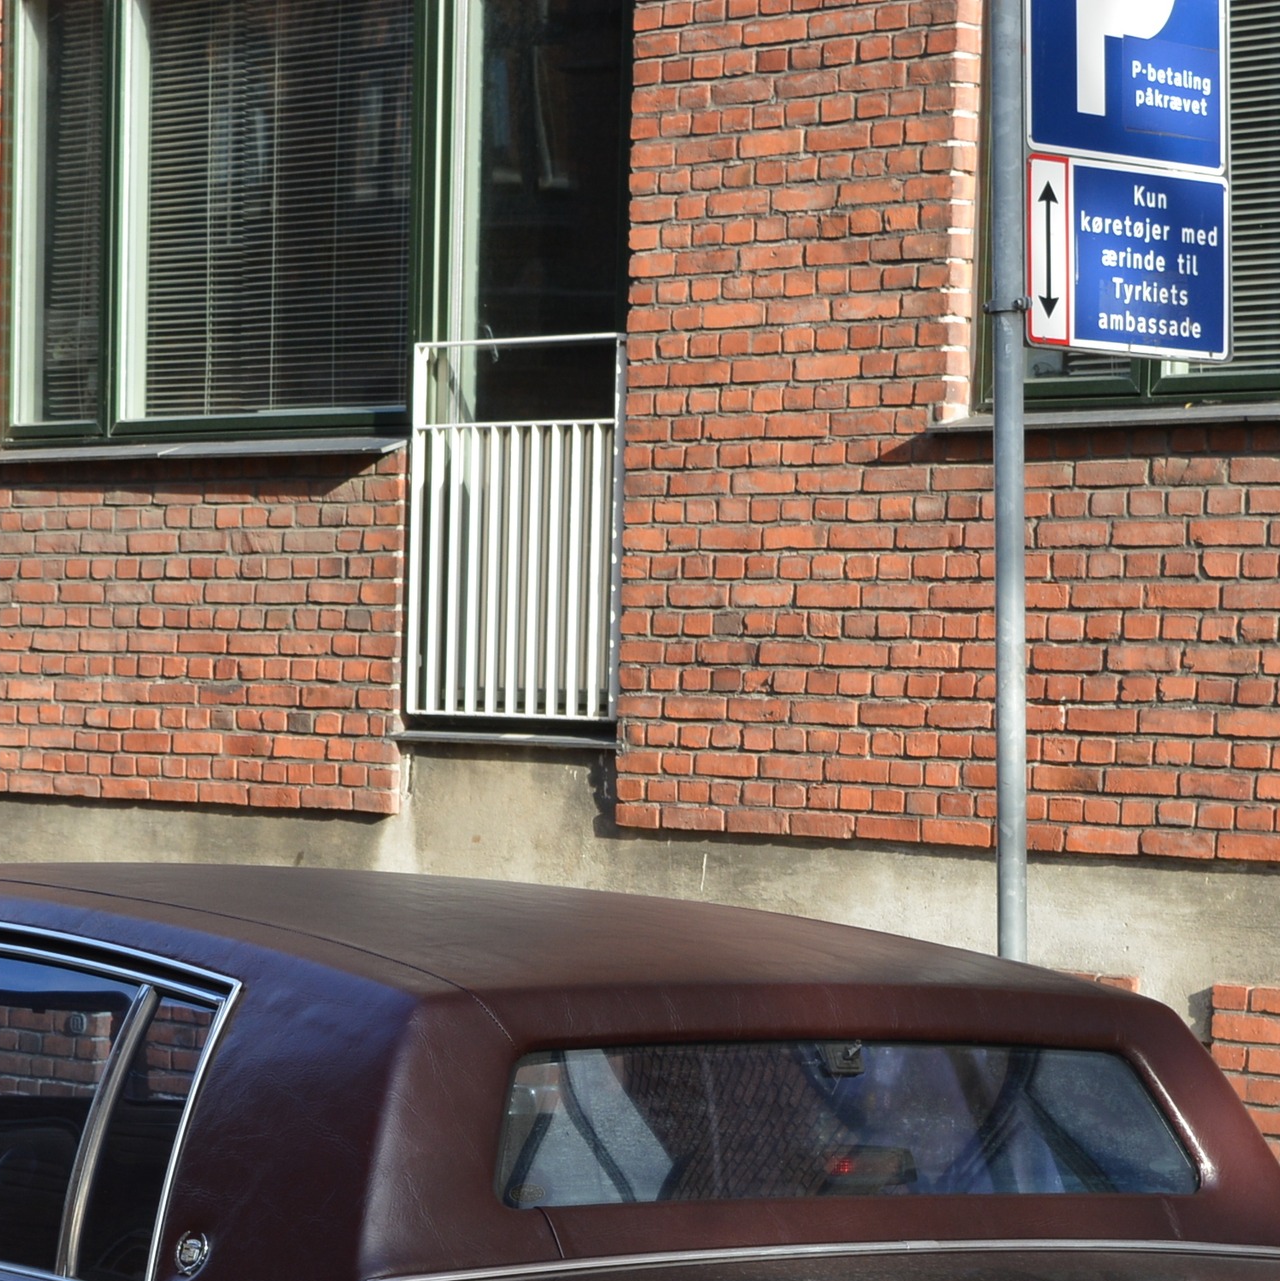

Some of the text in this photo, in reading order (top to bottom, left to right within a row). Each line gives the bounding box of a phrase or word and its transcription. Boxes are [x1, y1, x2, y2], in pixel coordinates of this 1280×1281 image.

[1131, 60, 1212, 96] P-betaling
[1135, 87, 1208, 116] påkrævet
[1133, 184, 1167, 209] Kun
[1080, 210, 1218, 247] køretøjer med
[1101, 247, 1199, 276] ærinde til
[1112, 276, 1189, 306] Tyrkiets
[1098, 310, 1202, 339] ambassade
